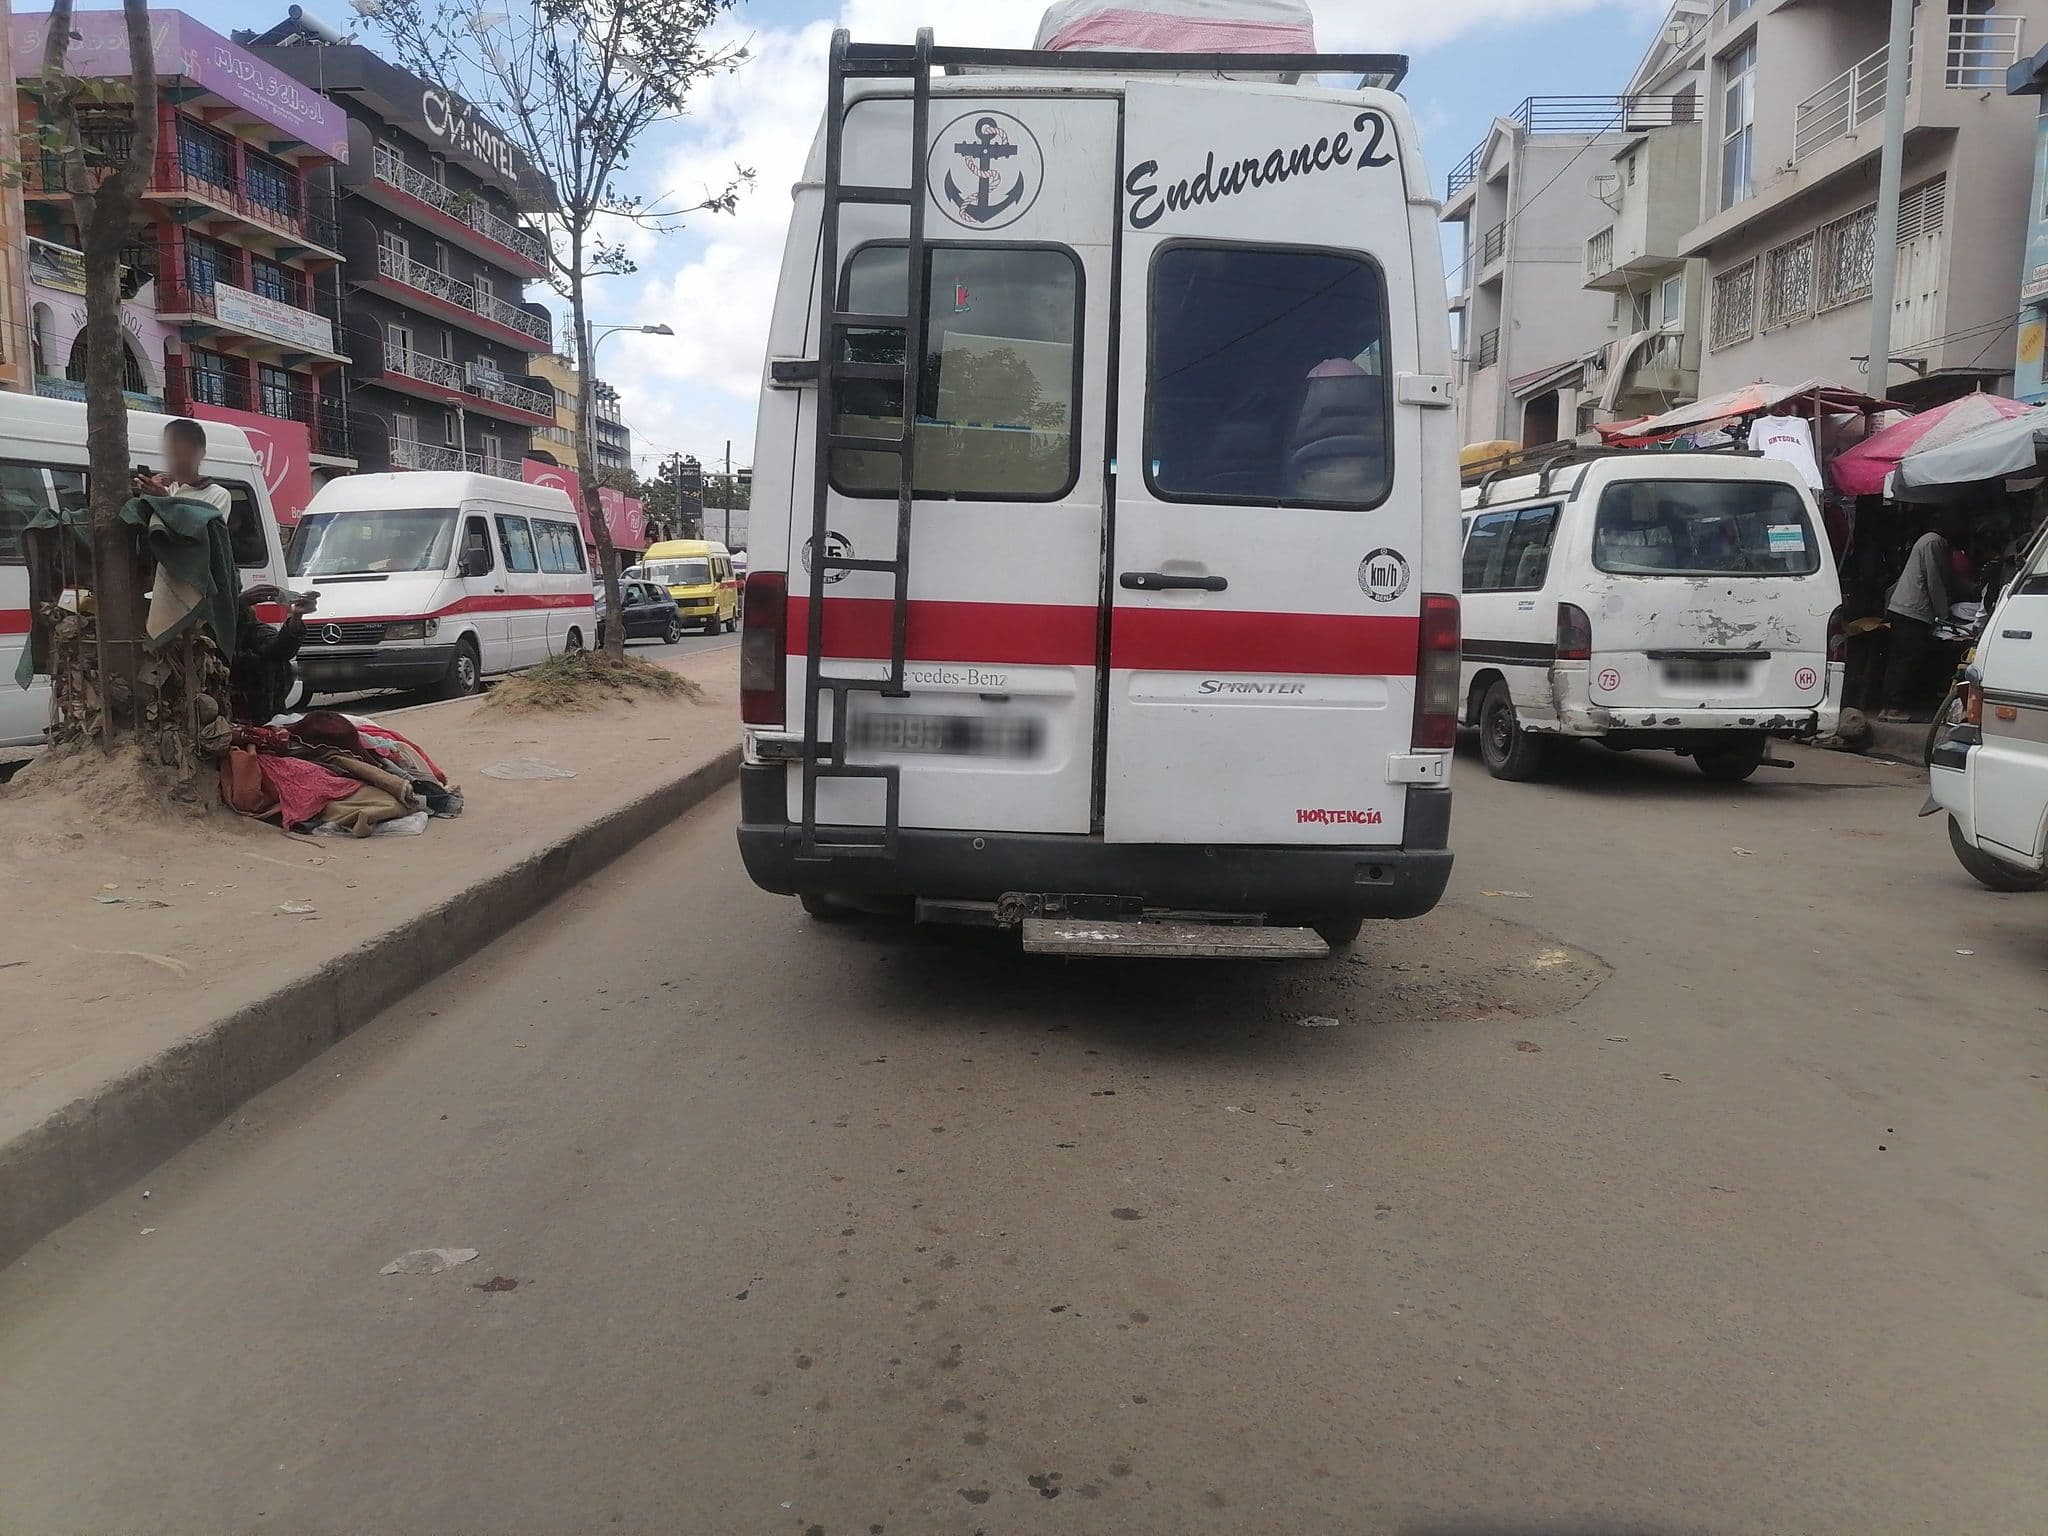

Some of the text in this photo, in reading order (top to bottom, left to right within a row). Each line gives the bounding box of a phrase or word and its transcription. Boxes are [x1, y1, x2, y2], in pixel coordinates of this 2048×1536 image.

[215, 47, 264, 90] MADA
[472, 121, 517, 181] HOTEL
[1126, 112, 1395, 229] Endurance 2
[1370, 562, 1397, 587] km/h
[1198, 679, 1306, 694] SPRINTER
[1602, 674, 1617, 687] 75
[1799, 673, 1813, 685] KH
